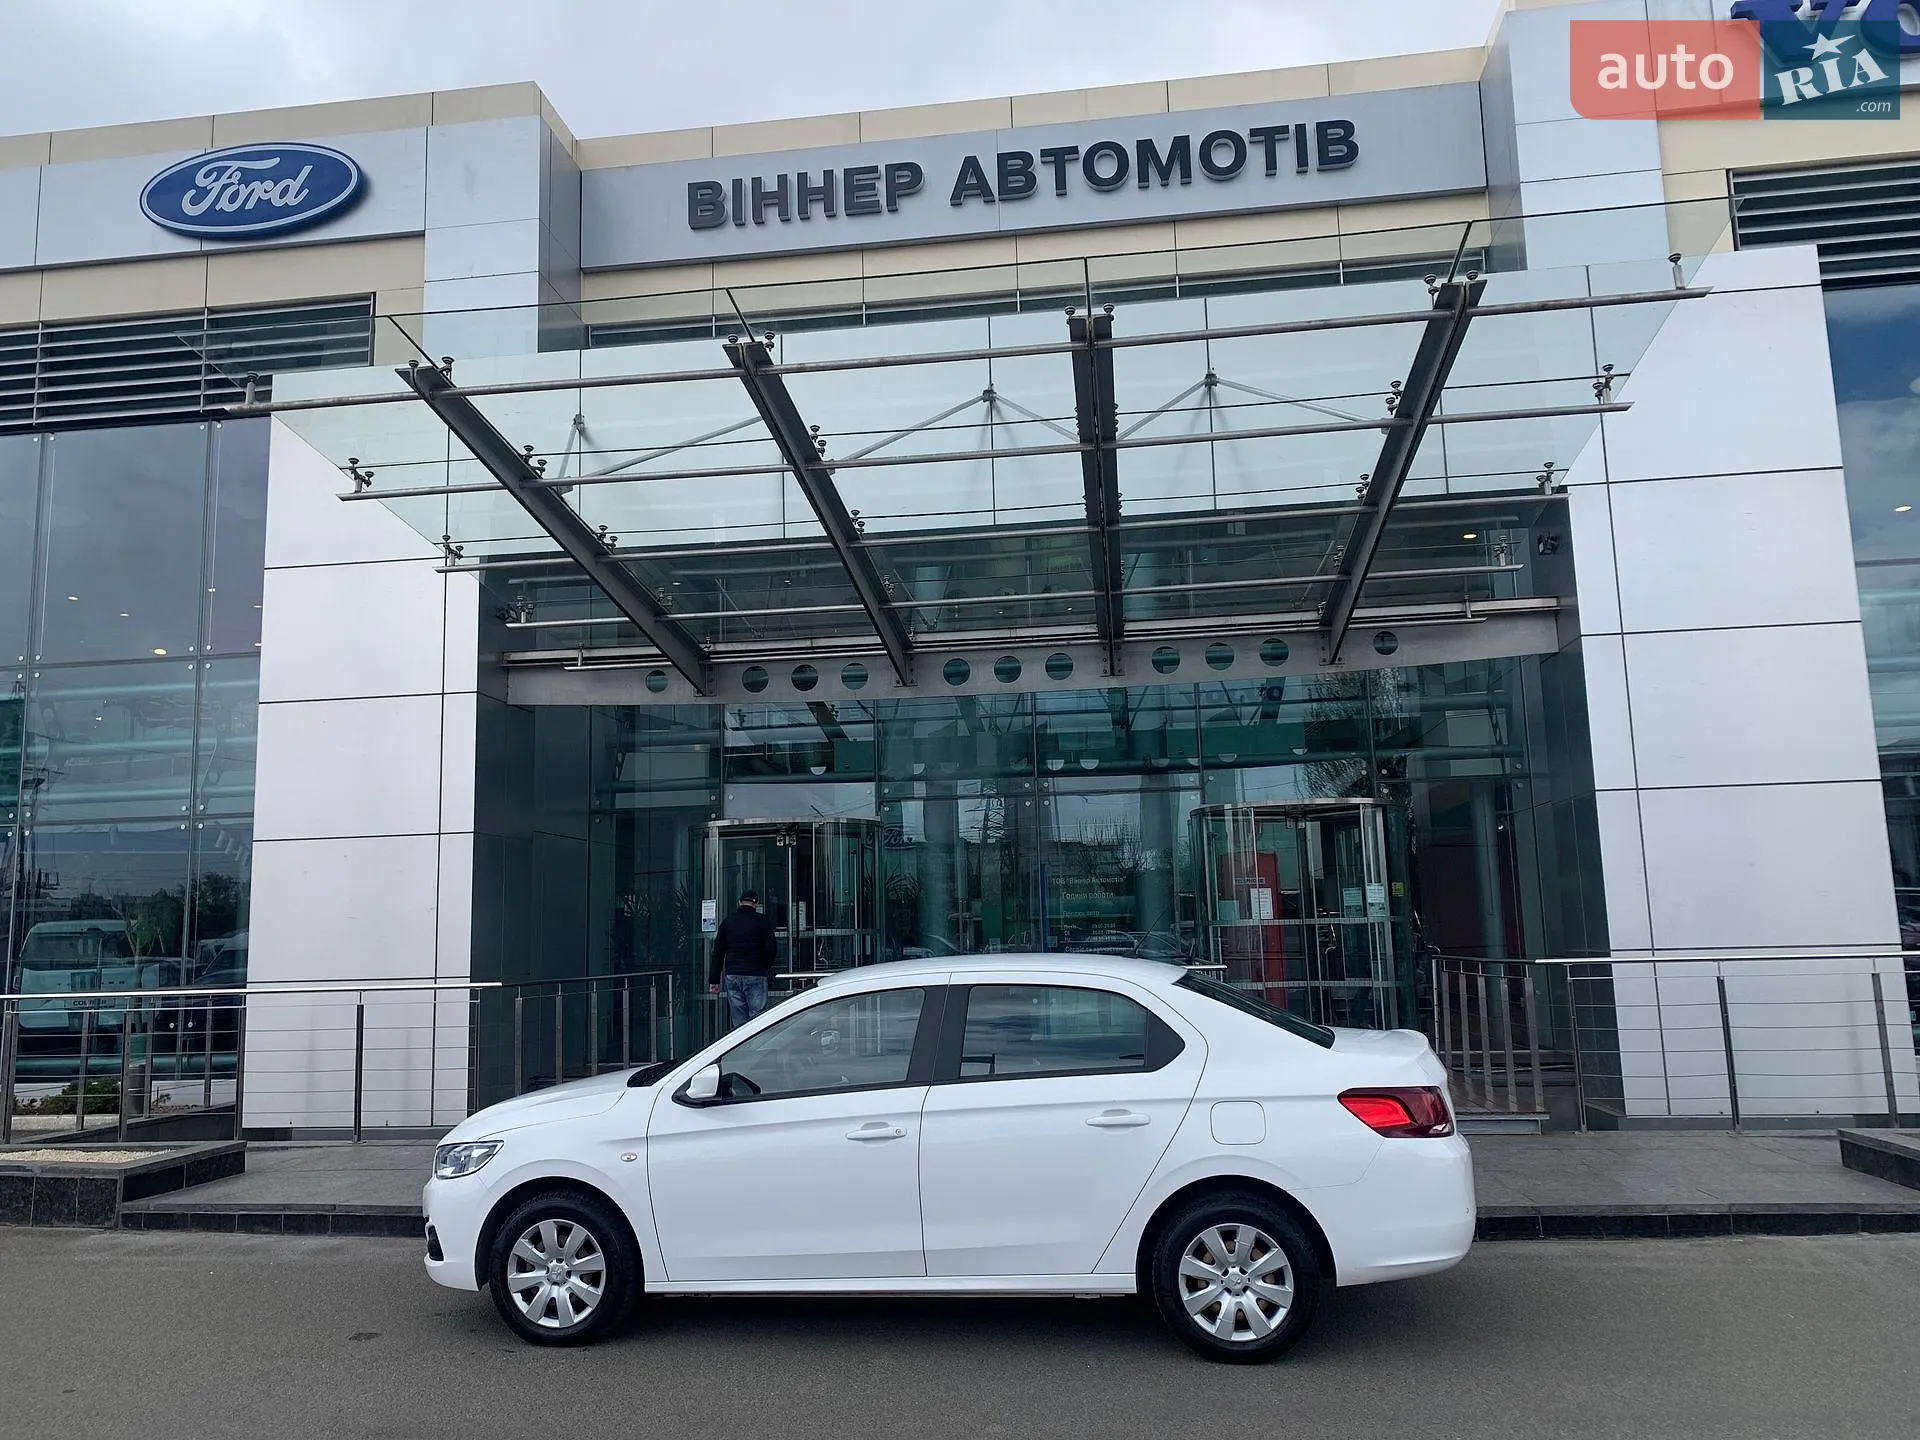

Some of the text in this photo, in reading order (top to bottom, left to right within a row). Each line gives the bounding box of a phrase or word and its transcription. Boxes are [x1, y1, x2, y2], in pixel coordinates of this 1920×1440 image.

[181, 157, 314, 216] Ford
[688, 119, 1361, 230] ВІННЕР АВТОМОТІВ
